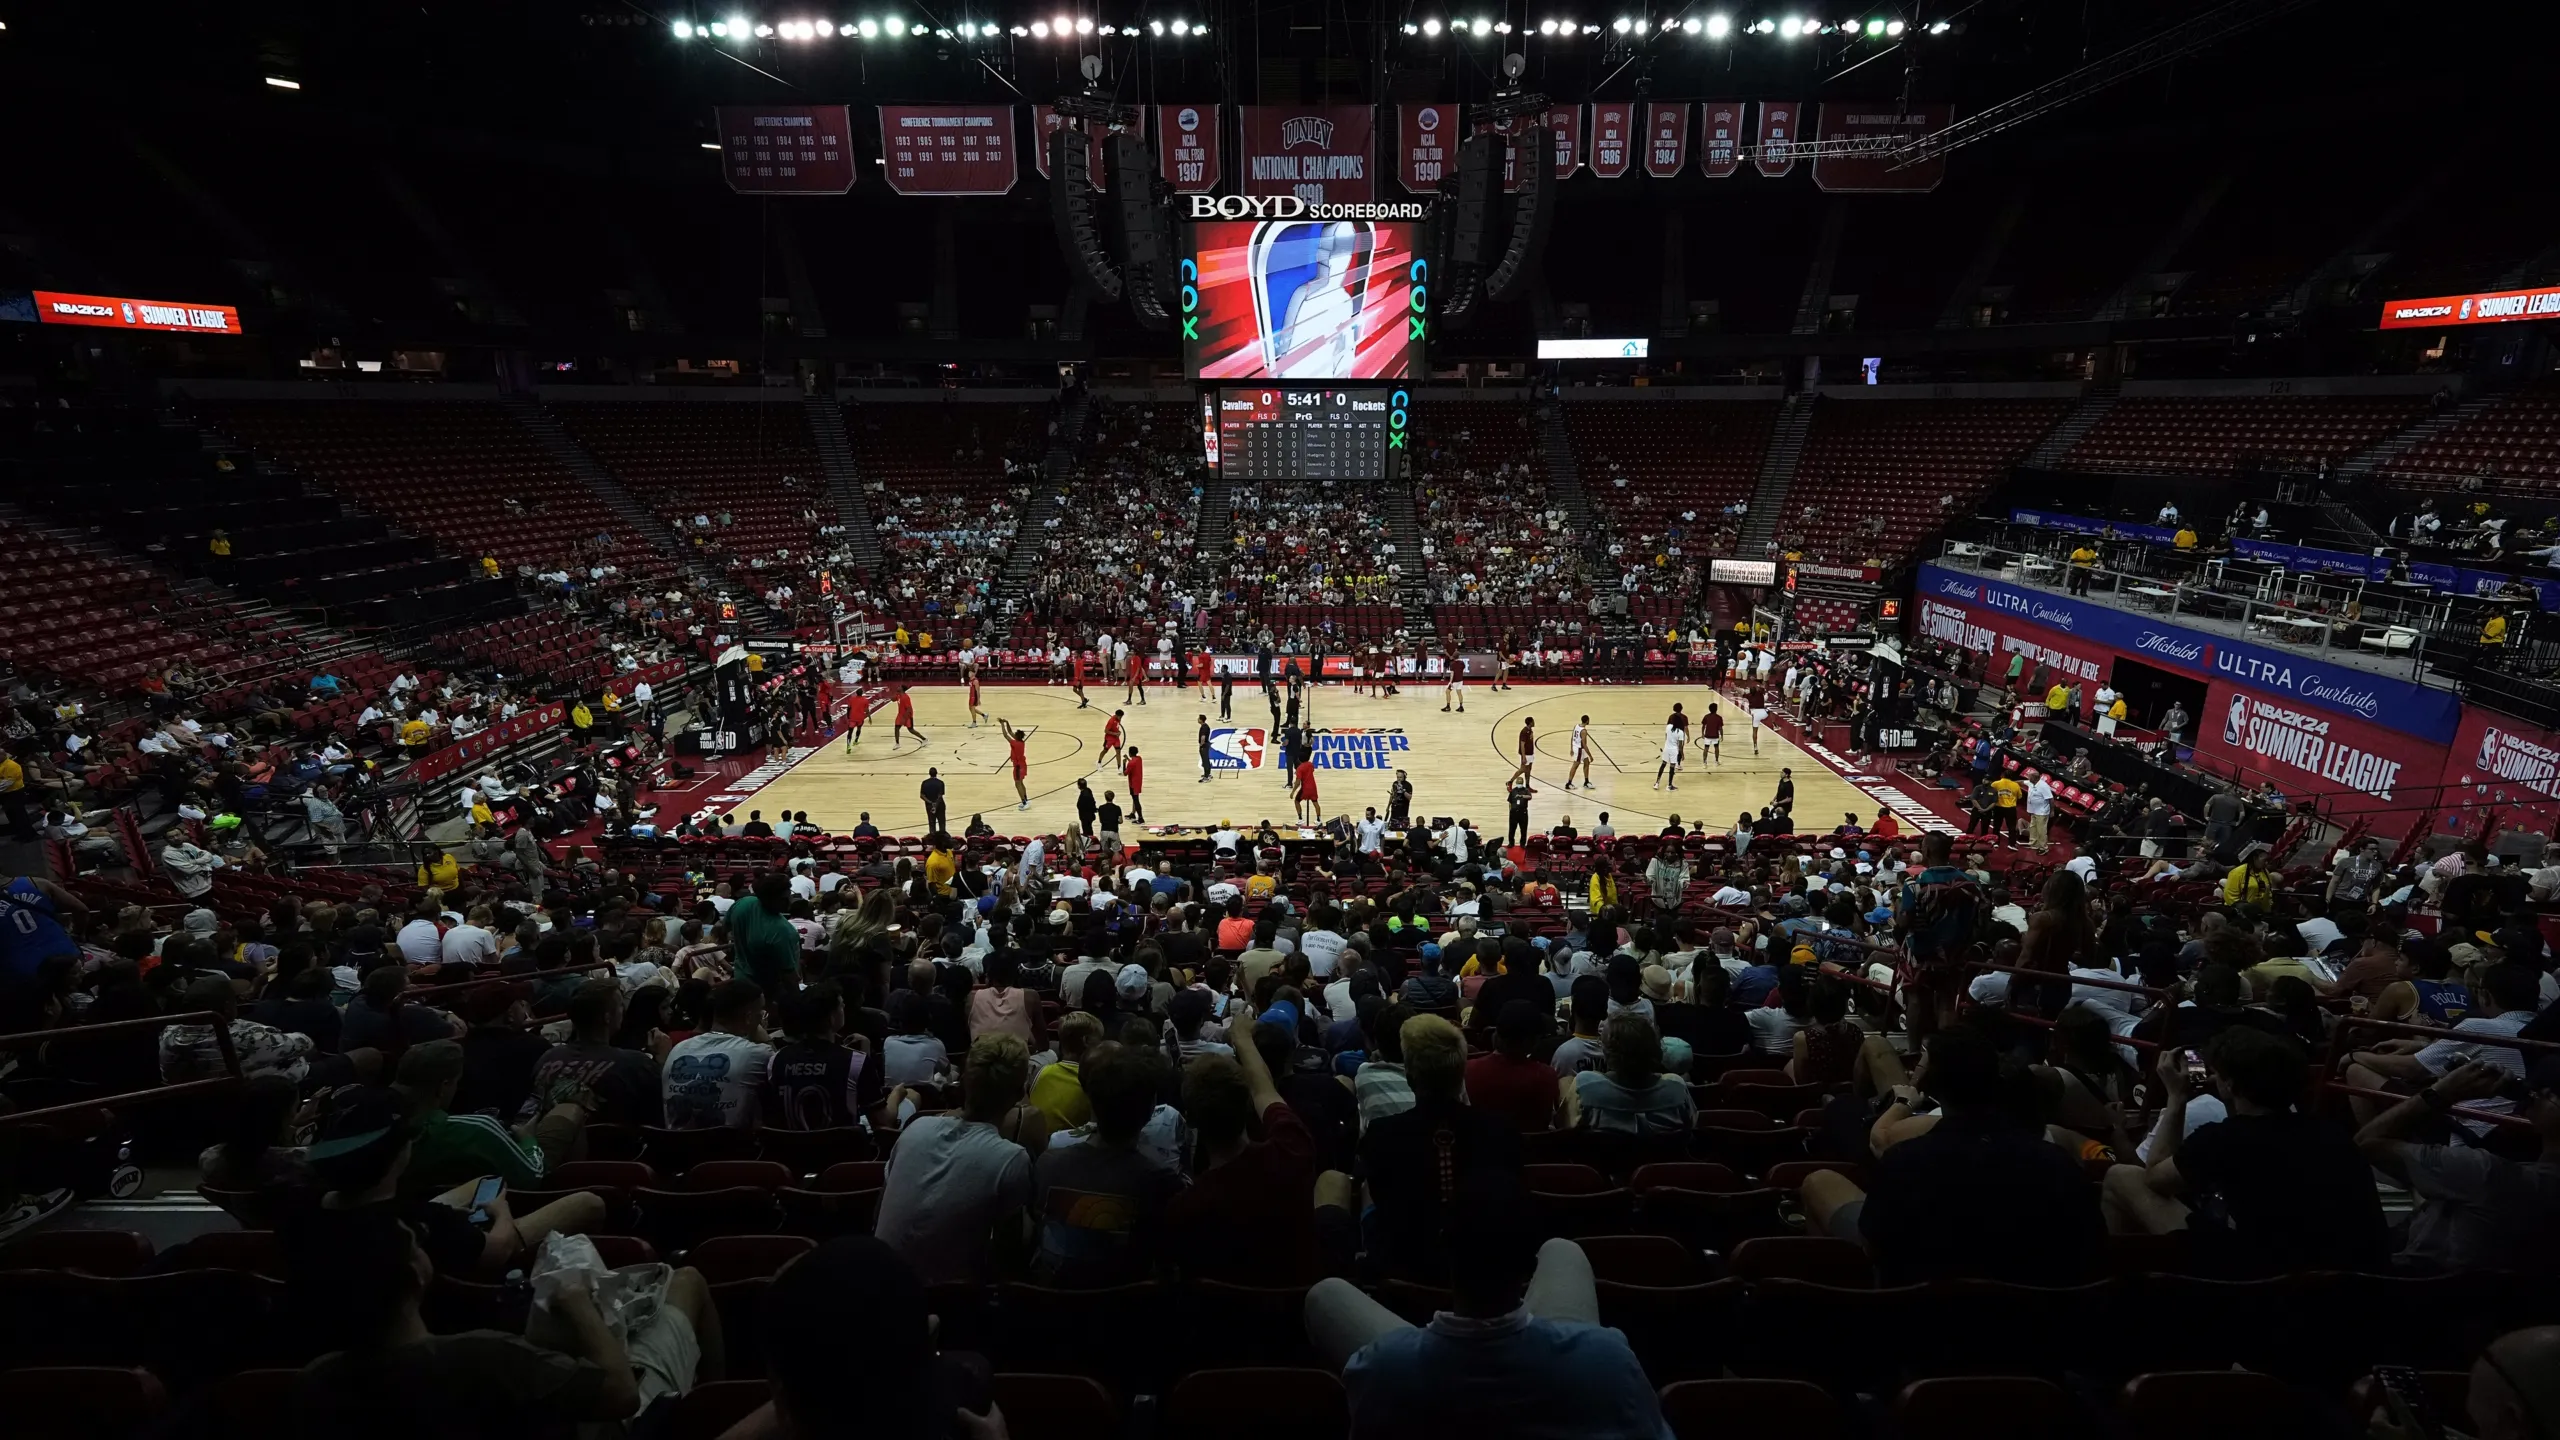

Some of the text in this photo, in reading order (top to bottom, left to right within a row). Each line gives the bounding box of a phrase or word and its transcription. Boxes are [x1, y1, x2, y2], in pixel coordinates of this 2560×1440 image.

[754, 117, 812, 126] CONFERENCE CHAMPIONS
[901, 116, 993, 127] CONFERENCE TOURNAMENT CHAMPIONS
[732, 136, 747, 145] 1975
[776, 136, 792, 145] 1984
[821, 136, 836, 145] 1986
[895, 136, 1000, 146] 1983 1985 1986 1987 1989
[1182, 134, 1196, 147] NCAA
[1421, 133, 1435, 146] NCAA
[1605, 129, 1617, 139] NCAA
[1661, 129, 1672, 139] NCAA
[897, 152, 912, 161] 1990
[919, 152, 933, 161] 1991
[963, 152, 979, 161] 2000
[986, 152, 1001, 161] 2007
[1175, 148, 1205, 161] FINAL FOUR
[1413, 148, 1442, 161] FINAL FOUR
[1600, 150, 1621, 165] 1986
[1656, 150, 1676, 165] 1984
[780, 167, 796, 176] 2000
[1177, 162, 1203, 182] 1987
[1252, 155, 1363, 180] NATIONAL CHAMPIONS
[1414, 162, 1441, 181] 1990
[1293, 183, 1324, 207] 1990
[1189, 195, 1423, 219] BOYD SCOREBOARD
[1181, 258, 1198, 341] COX
[1410, 258, 1427, 341] COX
[2395, 306, 2452, 319] NBA2K24
[2477, 295, 2527, 318] SUMMER
[53, 302, 228, 330] NBA2K24 SUMMER LEAGUE
[2269, 381, 2291, 394] 121
[1222, 392, 1385, 411] Cavaliers 0 5:41 0 Rockets
[1271, 413, 1277, 421] 0
[1295, 413, 1312, 421] PrG
[1344, 413, 1349, 421] 0
[1389, 390, 1408, 449] COX
[2253, 550, 2272, 558] ULTRA
[2322, 560, 2345, 569] ULTRA
[2409, 572, 2429, 581] LTRA
[1884, 607, 1895, 615] 24
[1932, 603, 1966, 620] NBA2K24
[1940, 579, 2073, 631] Michelob ULTRA Courtside
[1930, 613, 1997, 656] SUMMER LEAGUE
[1214, 659, 1248, 674] SUMMER
[2043, 648, 2063, 670] STARS
[2062, 655, 2081, 676] PLAY
[2080, 660, 2100, 681] HERE
[2136, 631, 2378, 718] Michelob ULTRA Courtside
[2252, 700, 2329, 736] NBA2K24
[700, 732, 711, 741] JOIN
[1901, 730, 1913, 739] JOIN
[700, 740, 715, 750] TODAY
[1901, 738, 1917, 748] TODAY
[2501, 734, 2560, 764] NBA2K24
[1209, 758, 1238, 767] NBA
[2245, 720, 2402, 802] SUMMER LEAGUE
[2493, 747, 2555, 794] SUMMER
[12, 909, 38, 934] 0
[2429, 992, 2468, 1006] POOLE
[785, 1063, 828, 1076] MESSI
[784, 1083, 833, 1132] 10
